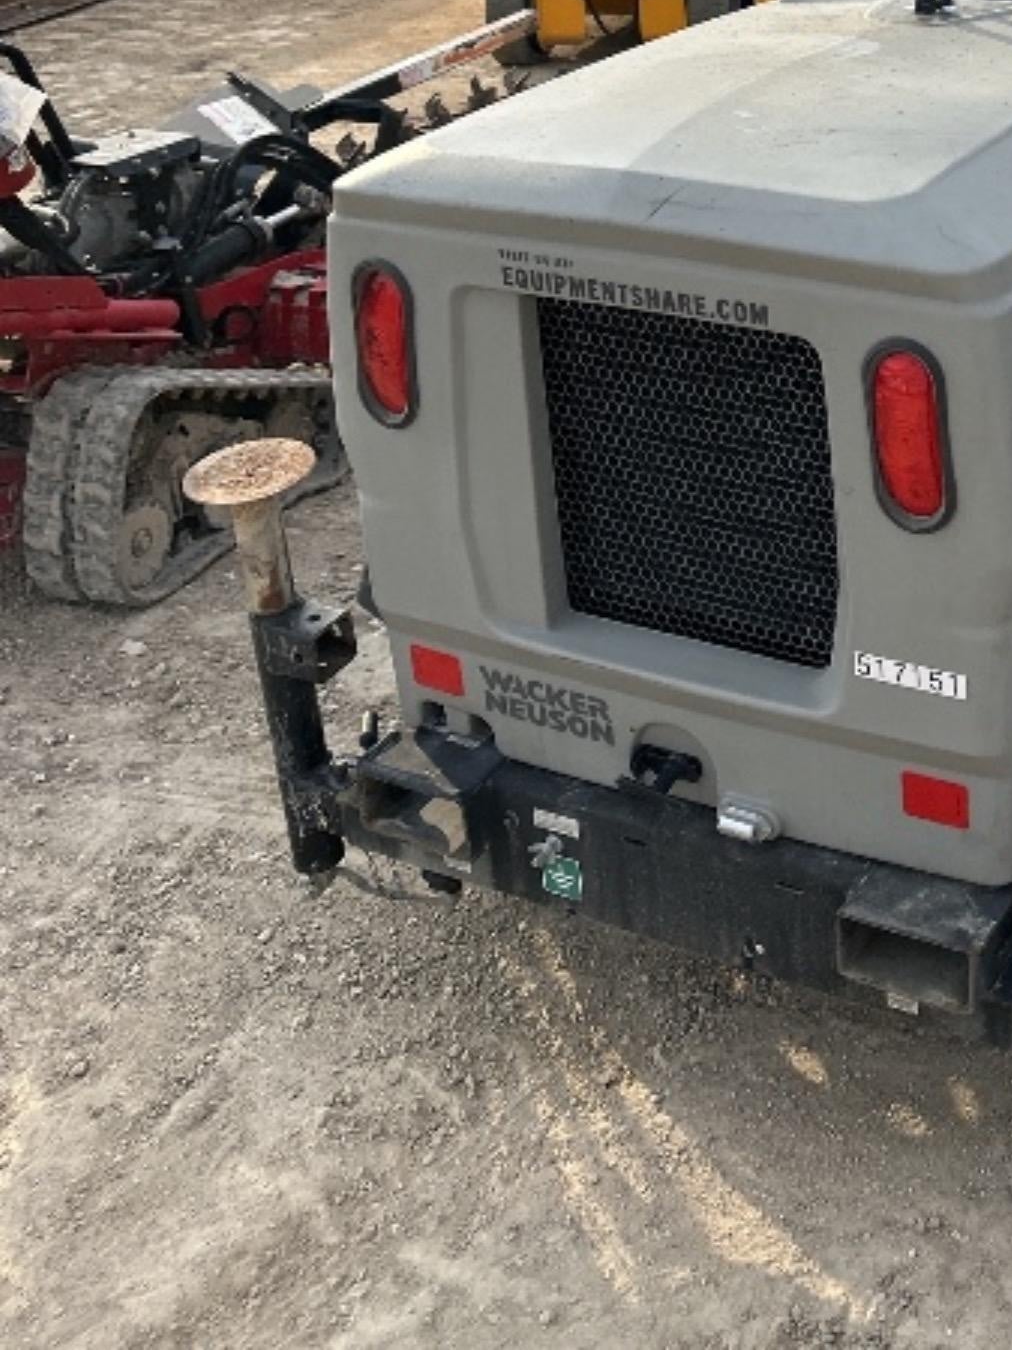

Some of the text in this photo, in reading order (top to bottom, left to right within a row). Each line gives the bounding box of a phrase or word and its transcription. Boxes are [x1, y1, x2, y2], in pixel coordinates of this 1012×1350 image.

[501, 266, 770, 327] EQUIPMENTSHARE.COM
[478, 664, 613, 725] WACKER
[856, 652, 960, 698] 517151
[484, 689, 616, 748] NEUSON
